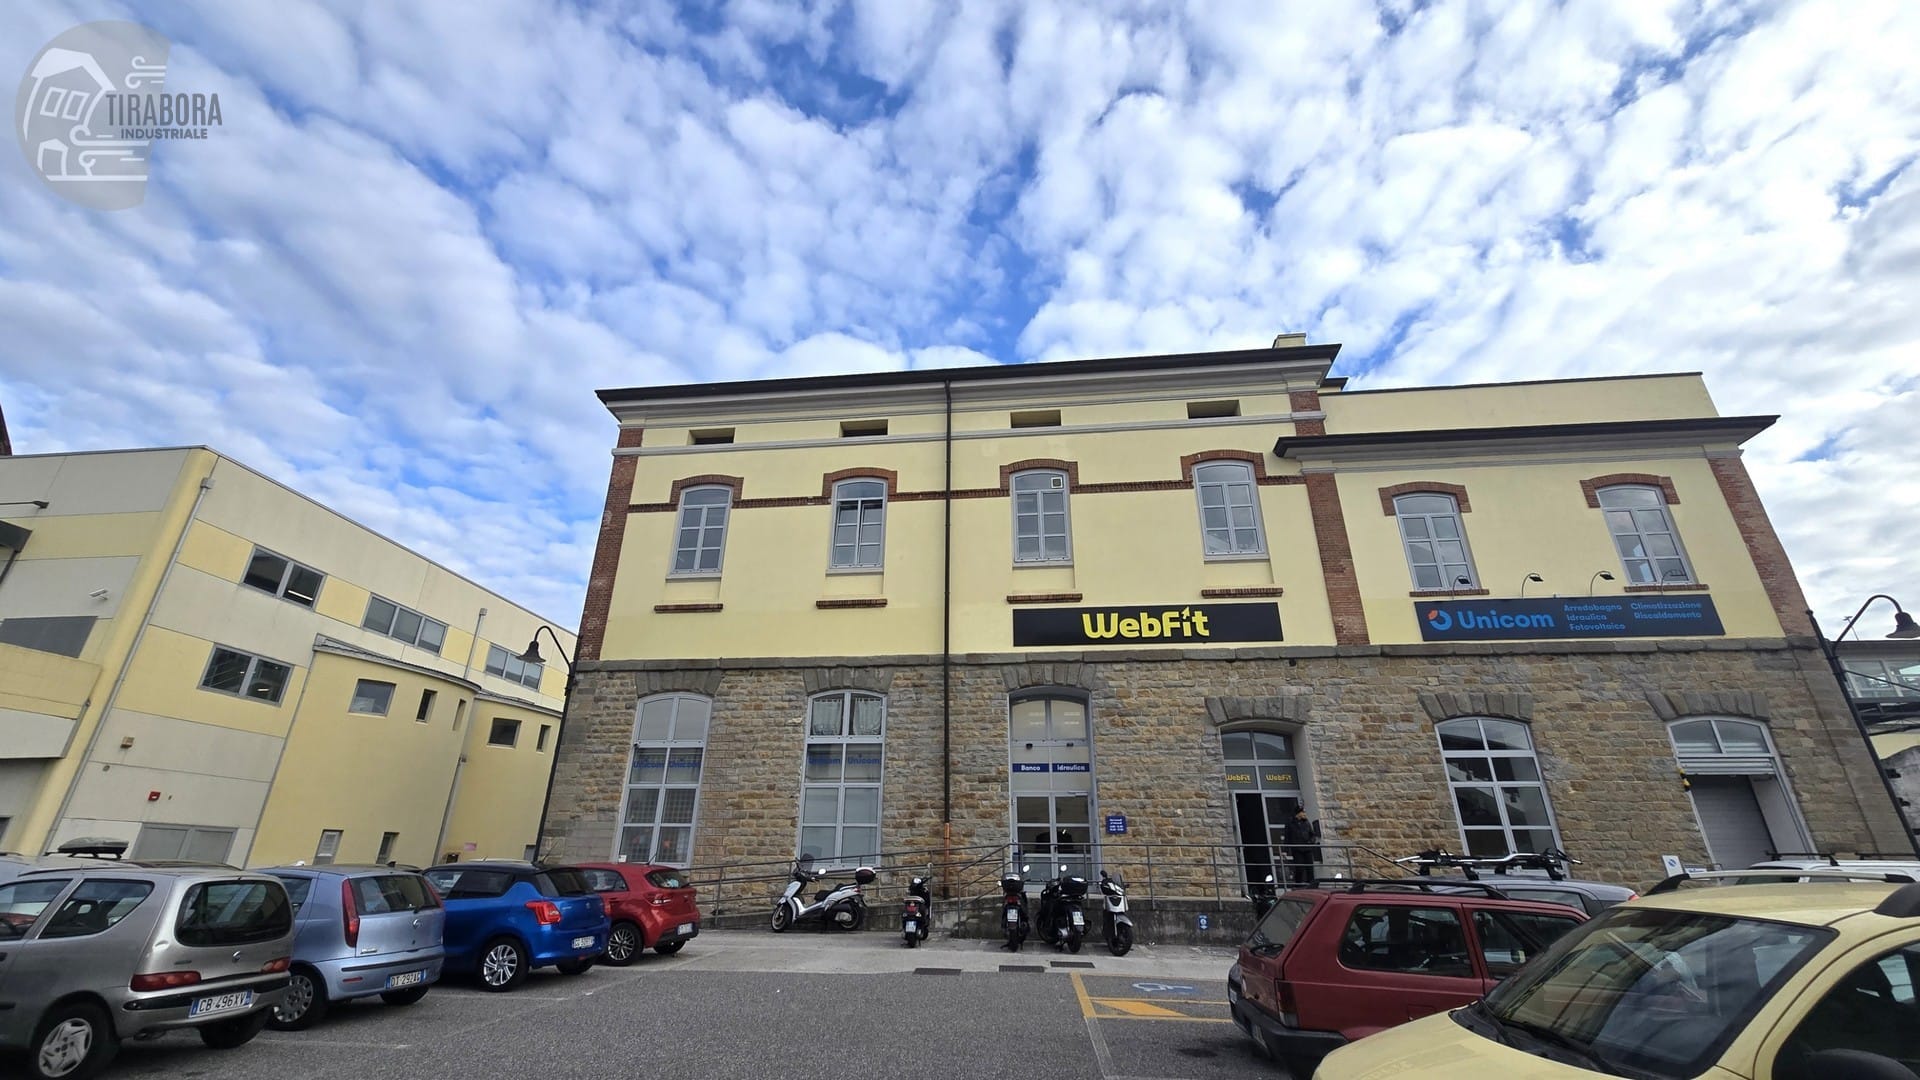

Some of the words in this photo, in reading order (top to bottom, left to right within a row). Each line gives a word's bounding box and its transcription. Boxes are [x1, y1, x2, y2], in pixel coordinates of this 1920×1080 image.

[1563, 604, 1622, 613] Arredobagno
[1630, 601, 1702, 610] Climatizzazione
[1566, 613, 1607, 621] Idraulica
[1634, 611, 1702, 619] Riscaldamento
[1082, 606, 1210, 639] WebFit
[1457, 610, 1555, 630] Unicom
[1569, 622, 1626, 631] Fotovoltaico
[1020, 764, 1041, 772] Banco
